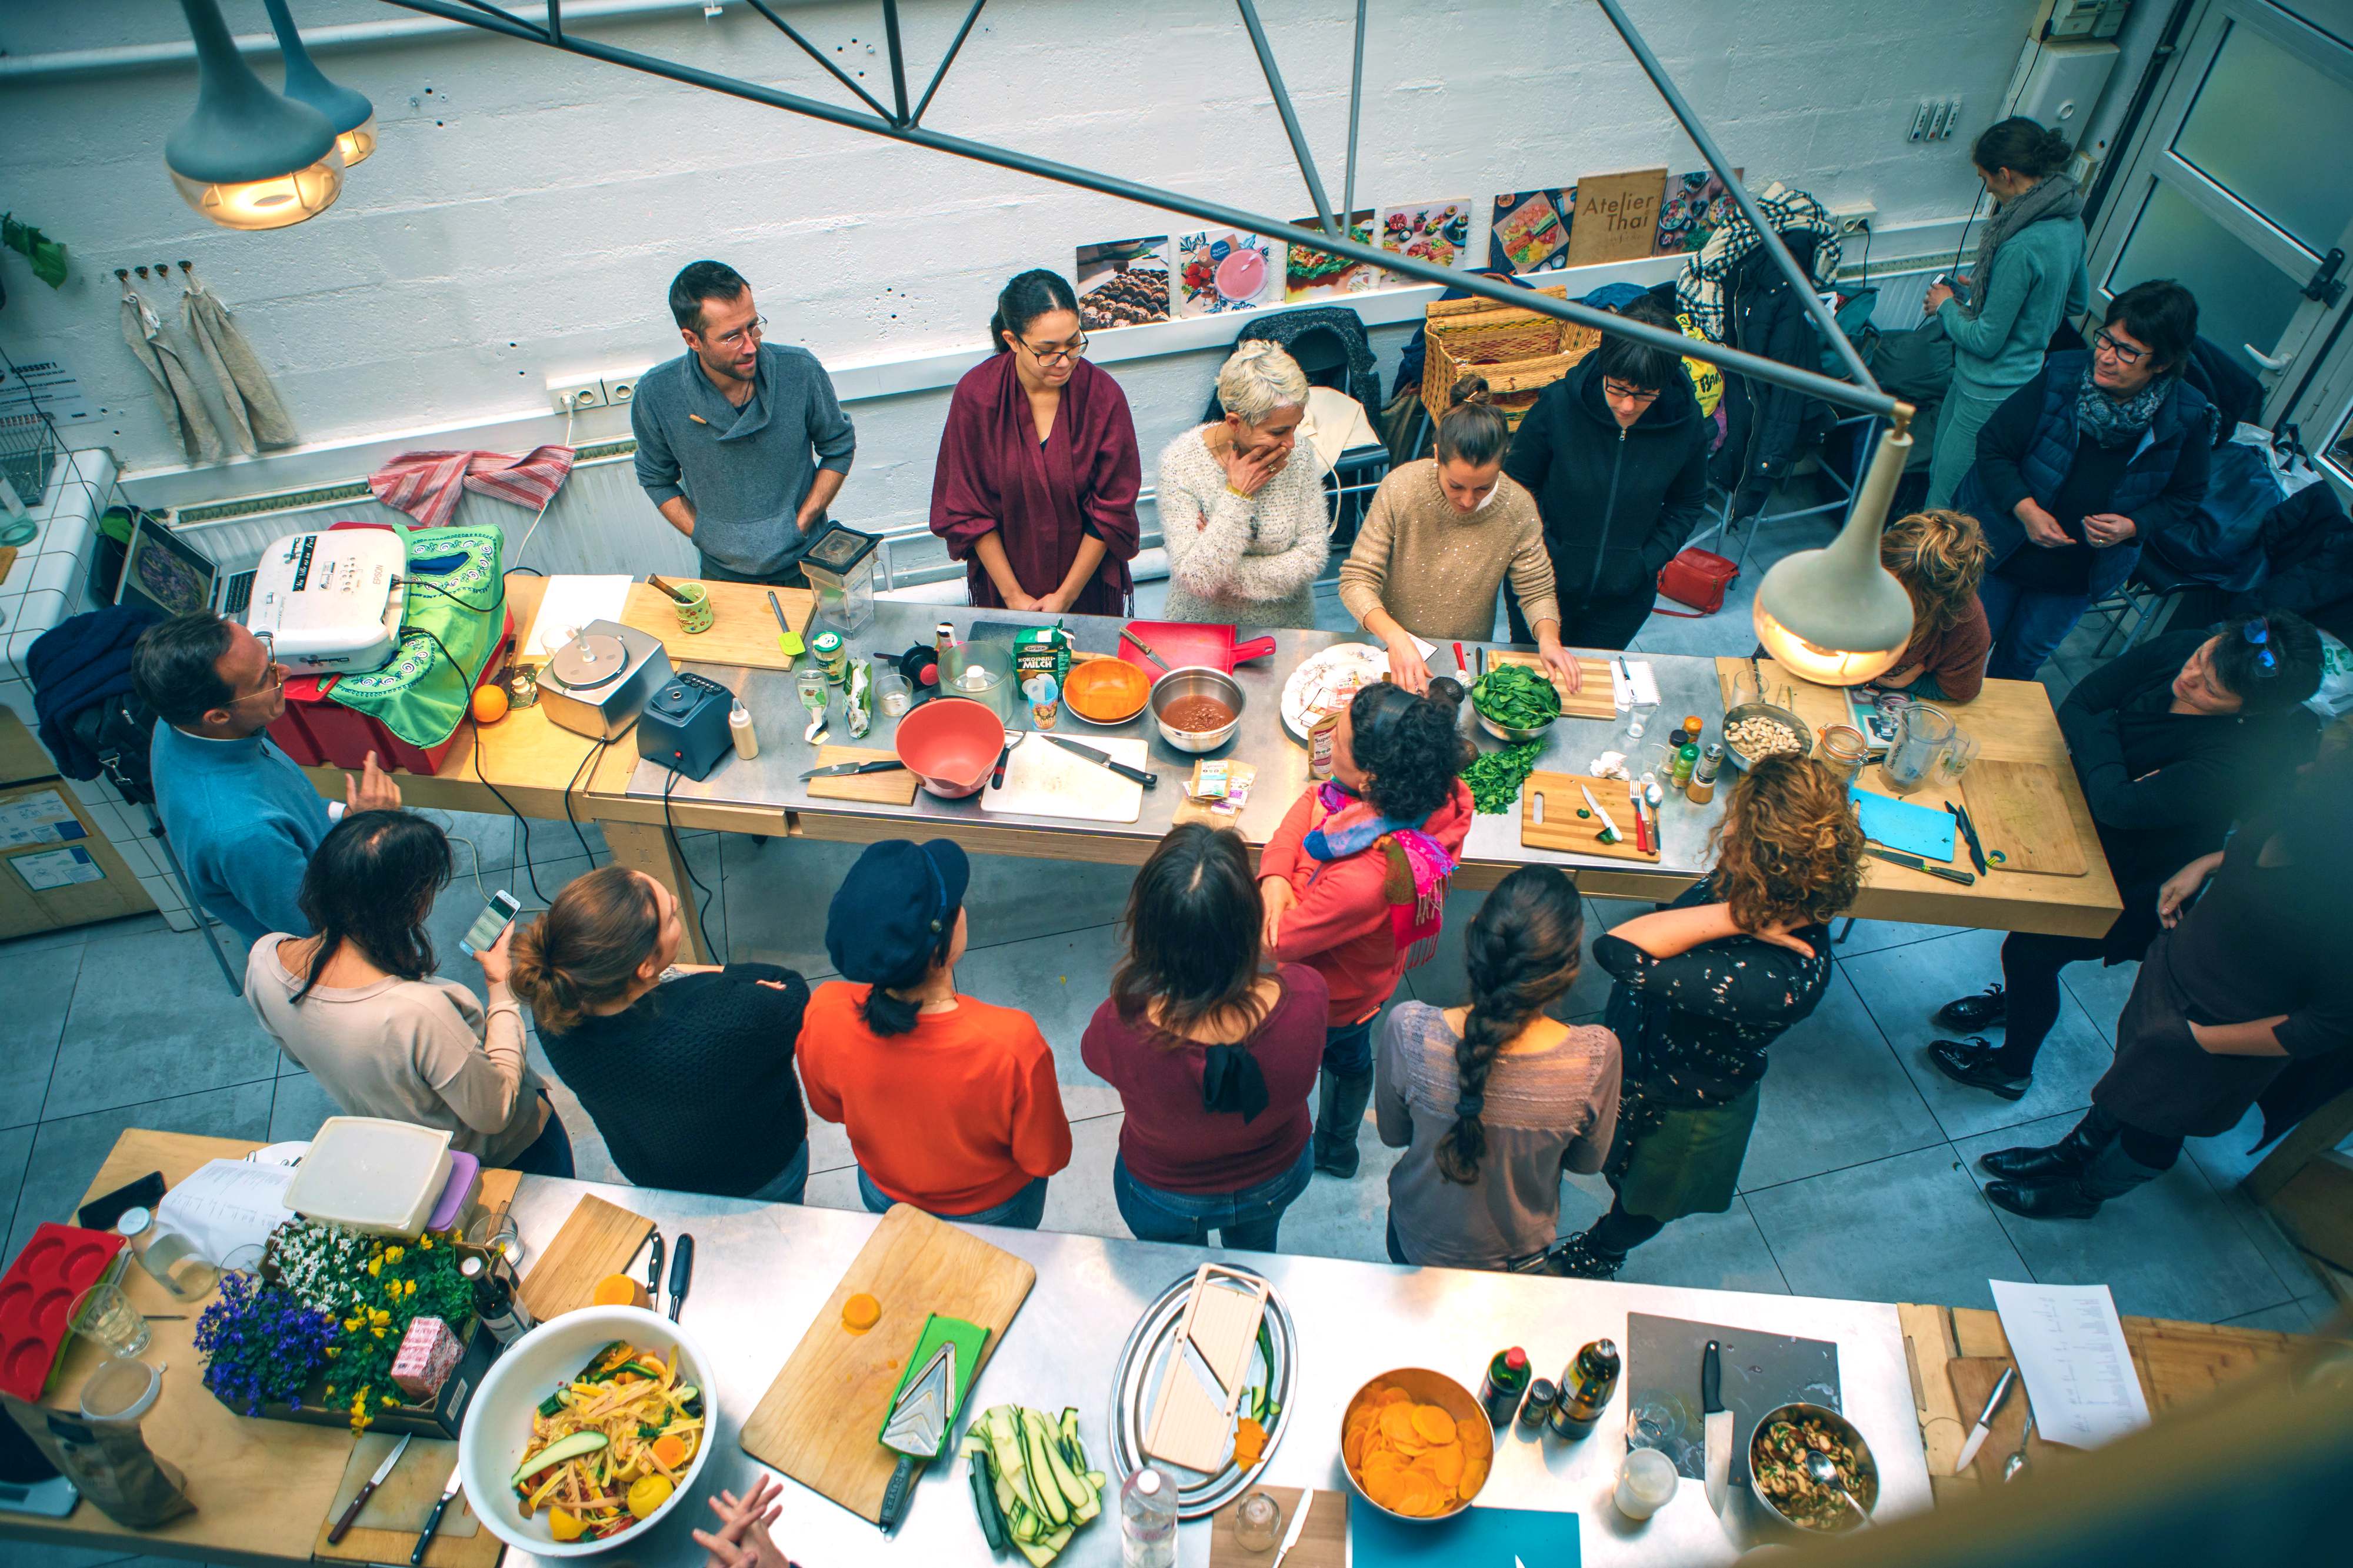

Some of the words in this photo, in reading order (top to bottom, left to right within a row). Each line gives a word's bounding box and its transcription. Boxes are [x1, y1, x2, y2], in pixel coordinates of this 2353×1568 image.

[1582, 192, 1654, 216] Atelier
[373, 565, 384, 585] EPSON
[1022, 660, 1052, 669] MILCH
[884, 1476, 904, 1510] BUYER
